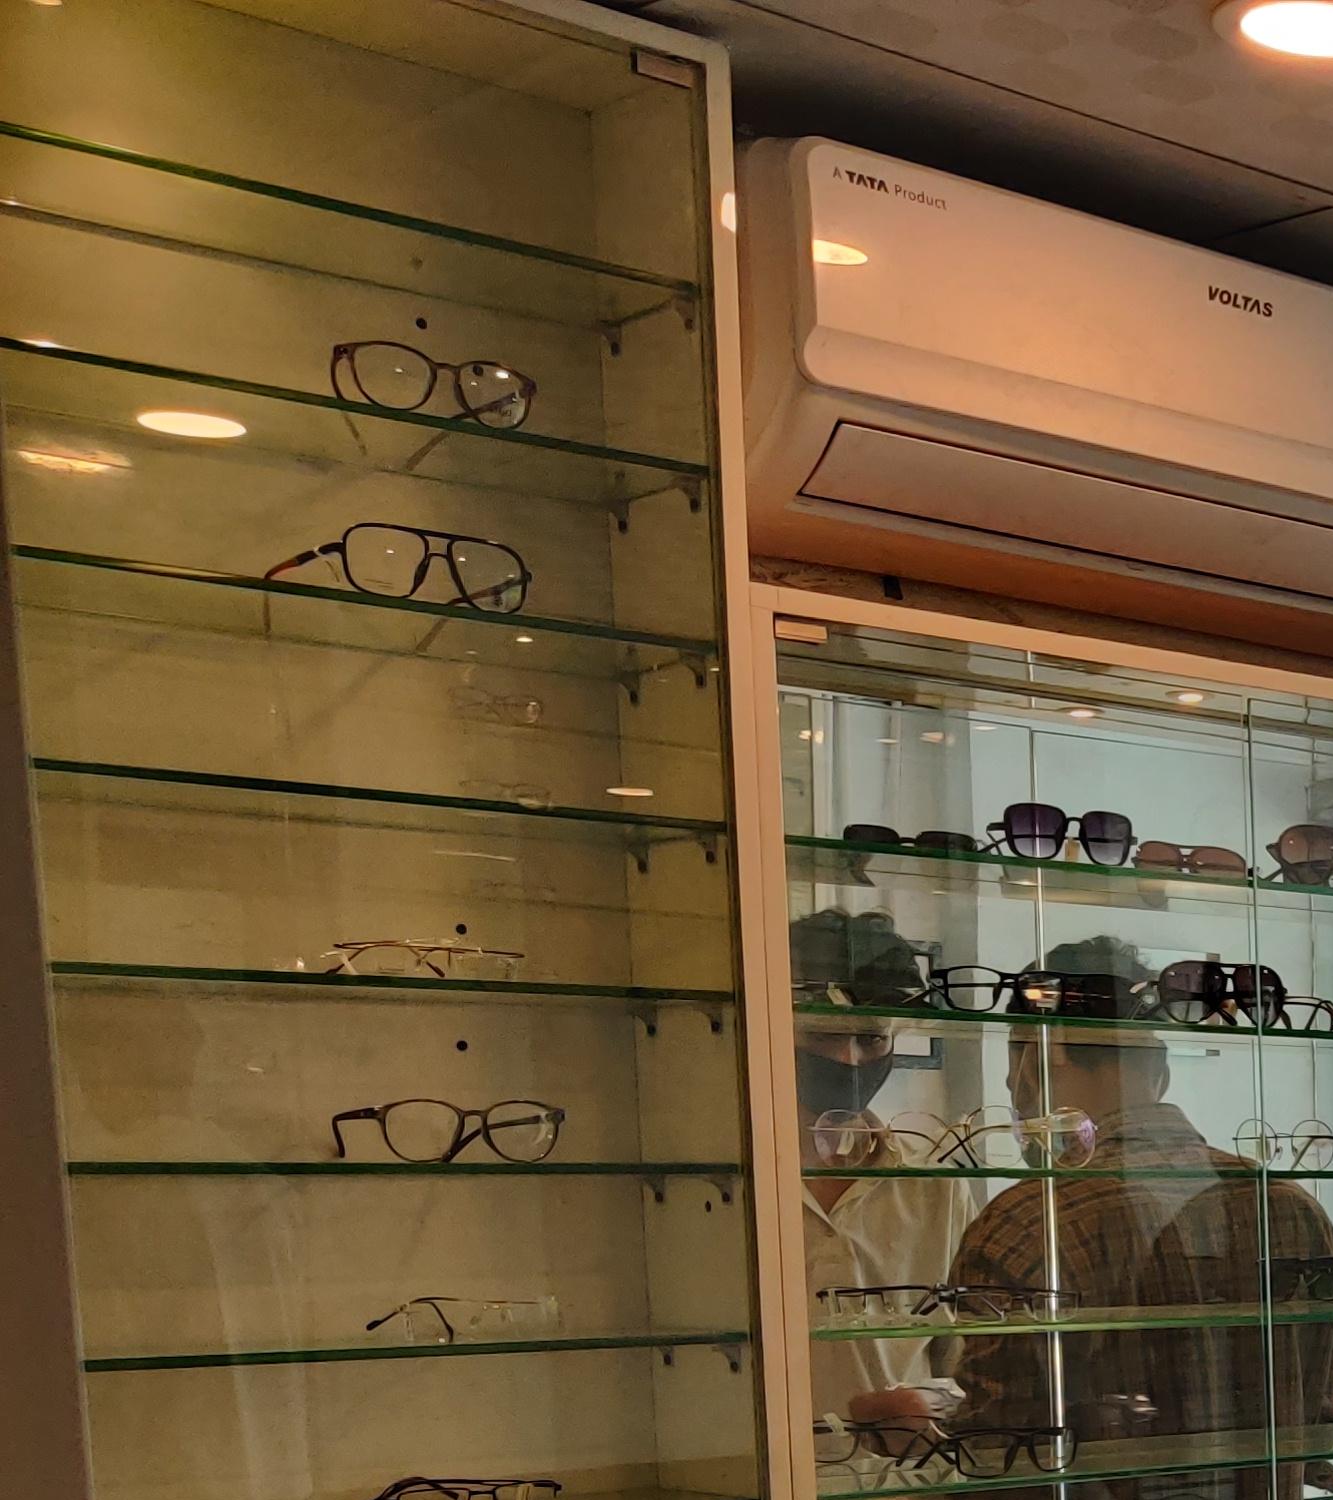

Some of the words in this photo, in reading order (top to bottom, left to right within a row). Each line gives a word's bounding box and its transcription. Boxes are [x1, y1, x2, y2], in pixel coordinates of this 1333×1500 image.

[832, 166, 842, 180] A
[844, 169, 890, 194] TATA
[894, 183, 948, 210] Product
[1208, 285, 1274, 317] VOLTAS
